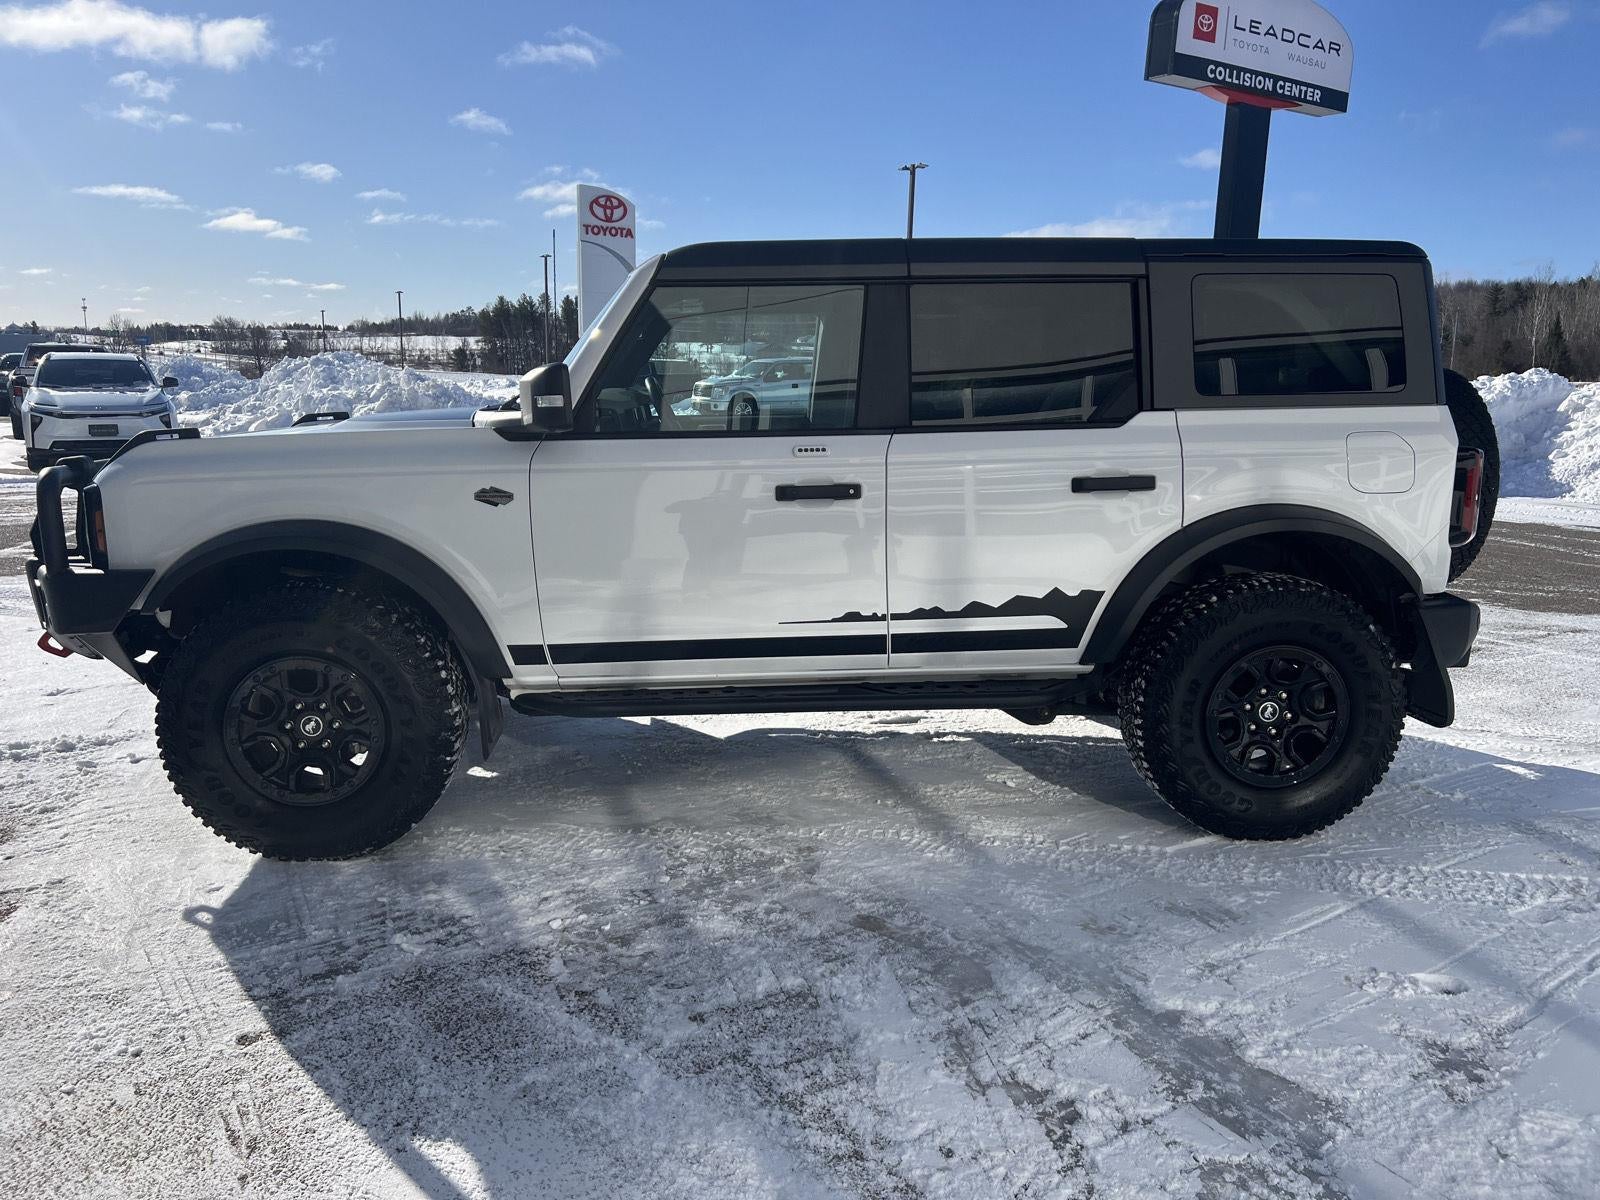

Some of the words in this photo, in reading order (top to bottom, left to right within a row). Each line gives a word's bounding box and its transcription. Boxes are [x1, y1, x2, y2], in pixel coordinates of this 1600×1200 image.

[1233, 14, 1341, 57] LEADCAR
[1232, 38, 1270, 56] TOYOTA
[1287, 52, 1327, 70] WAUSAU
[1206, 64, 1273, 92] COLLISION
[1276, 80, 1321, 103] CENTER
[582, 223, 634, 239] TOYOTA
